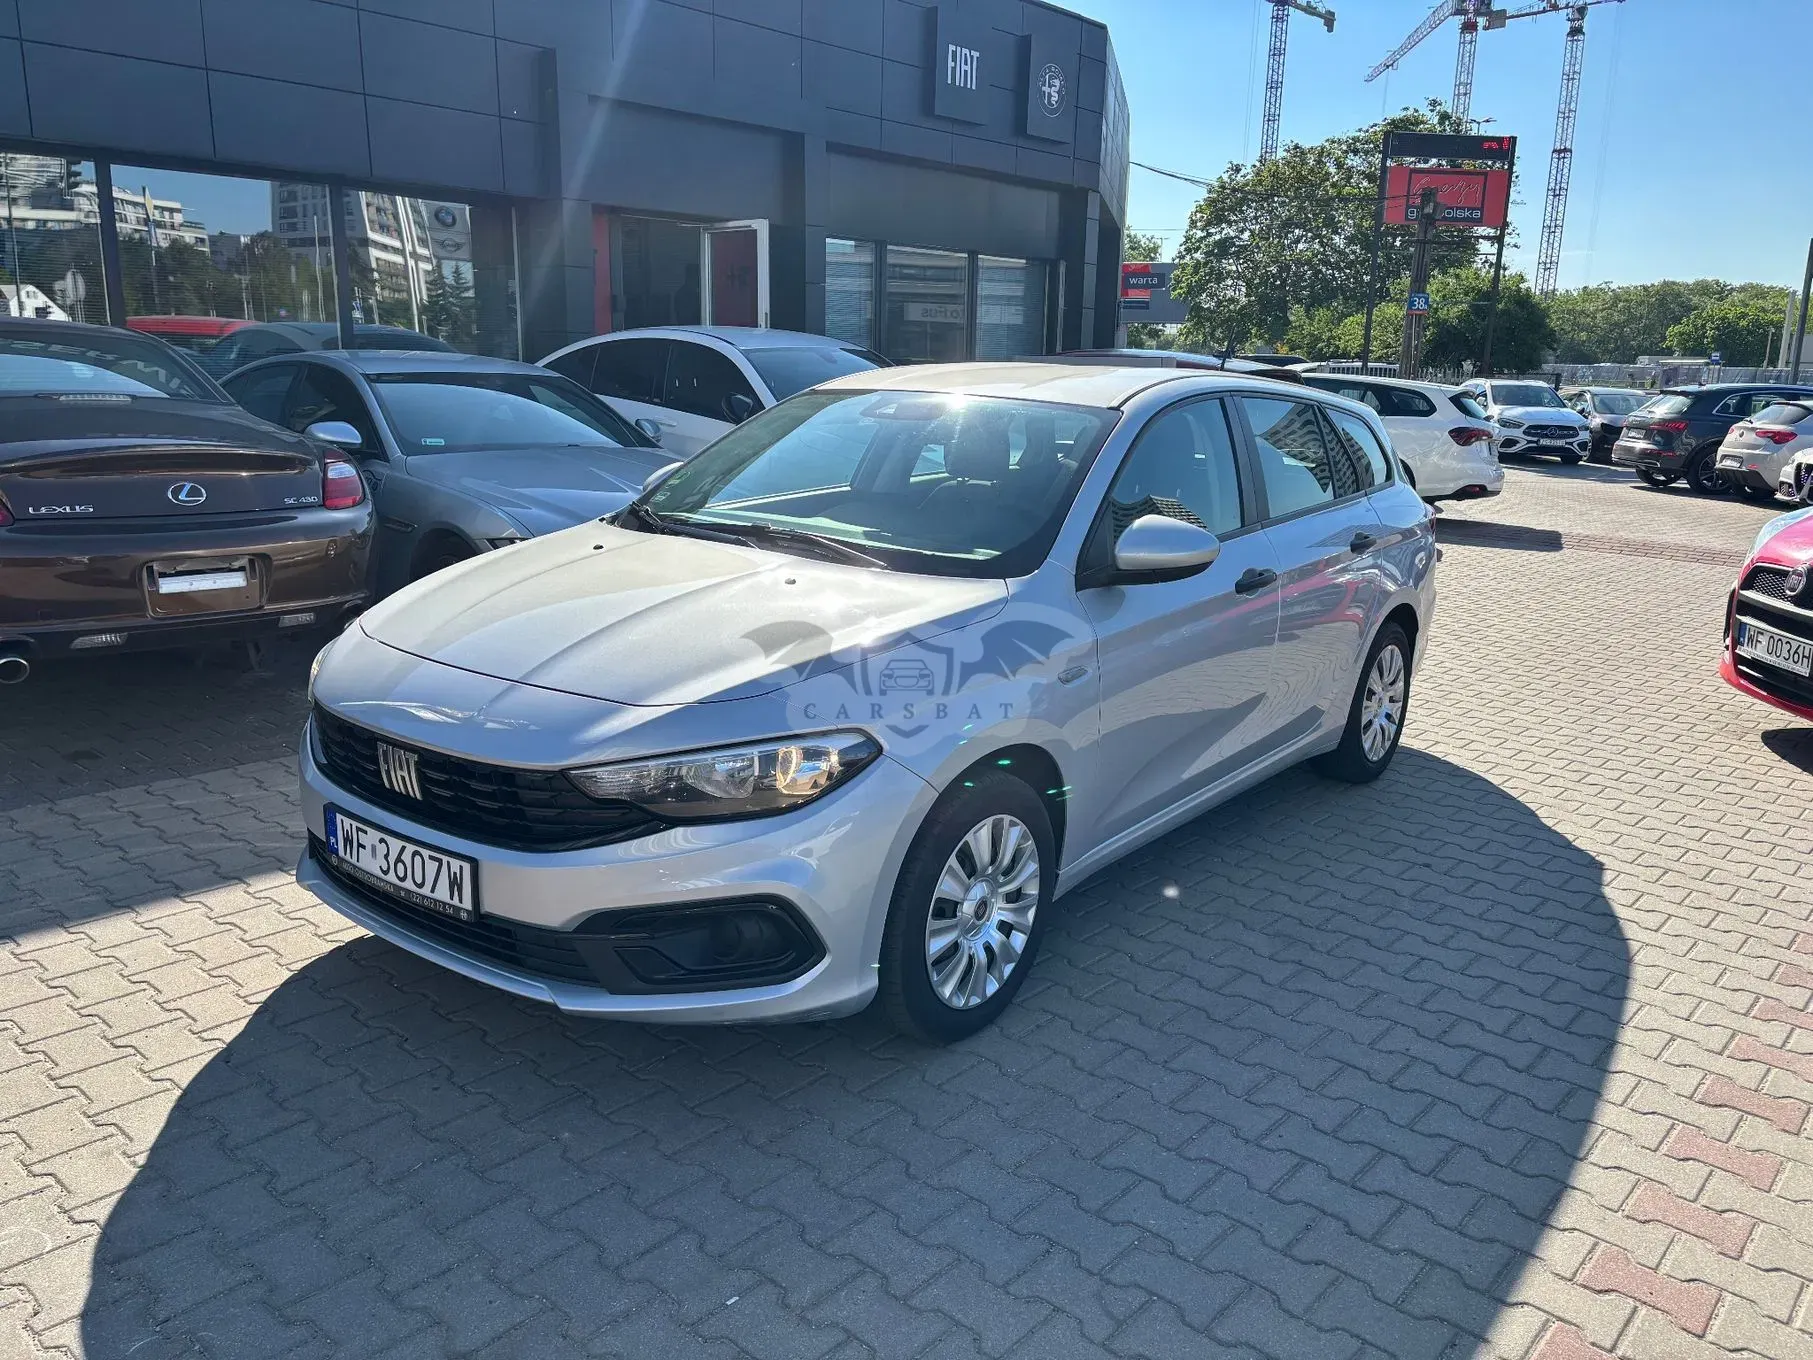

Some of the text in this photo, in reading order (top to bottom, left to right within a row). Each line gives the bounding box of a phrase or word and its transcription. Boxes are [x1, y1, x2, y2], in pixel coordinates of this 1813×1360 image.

[947, 43, 980, 91] FIAT
[1128, 276, 1158, 285] warta
[28, 504, 94, 514] LEXUS
[1746, 625, 1765, 649] WF
[1766, 635, 1812, 669] 0036H
[377, 741, 423, 800] FIAT
[329, 835, 338, 849] PL
[340, 818, 464, 904] WF 3607W
[423, 897, 435, 908] 612
[445, 905, 454, 914] 54
